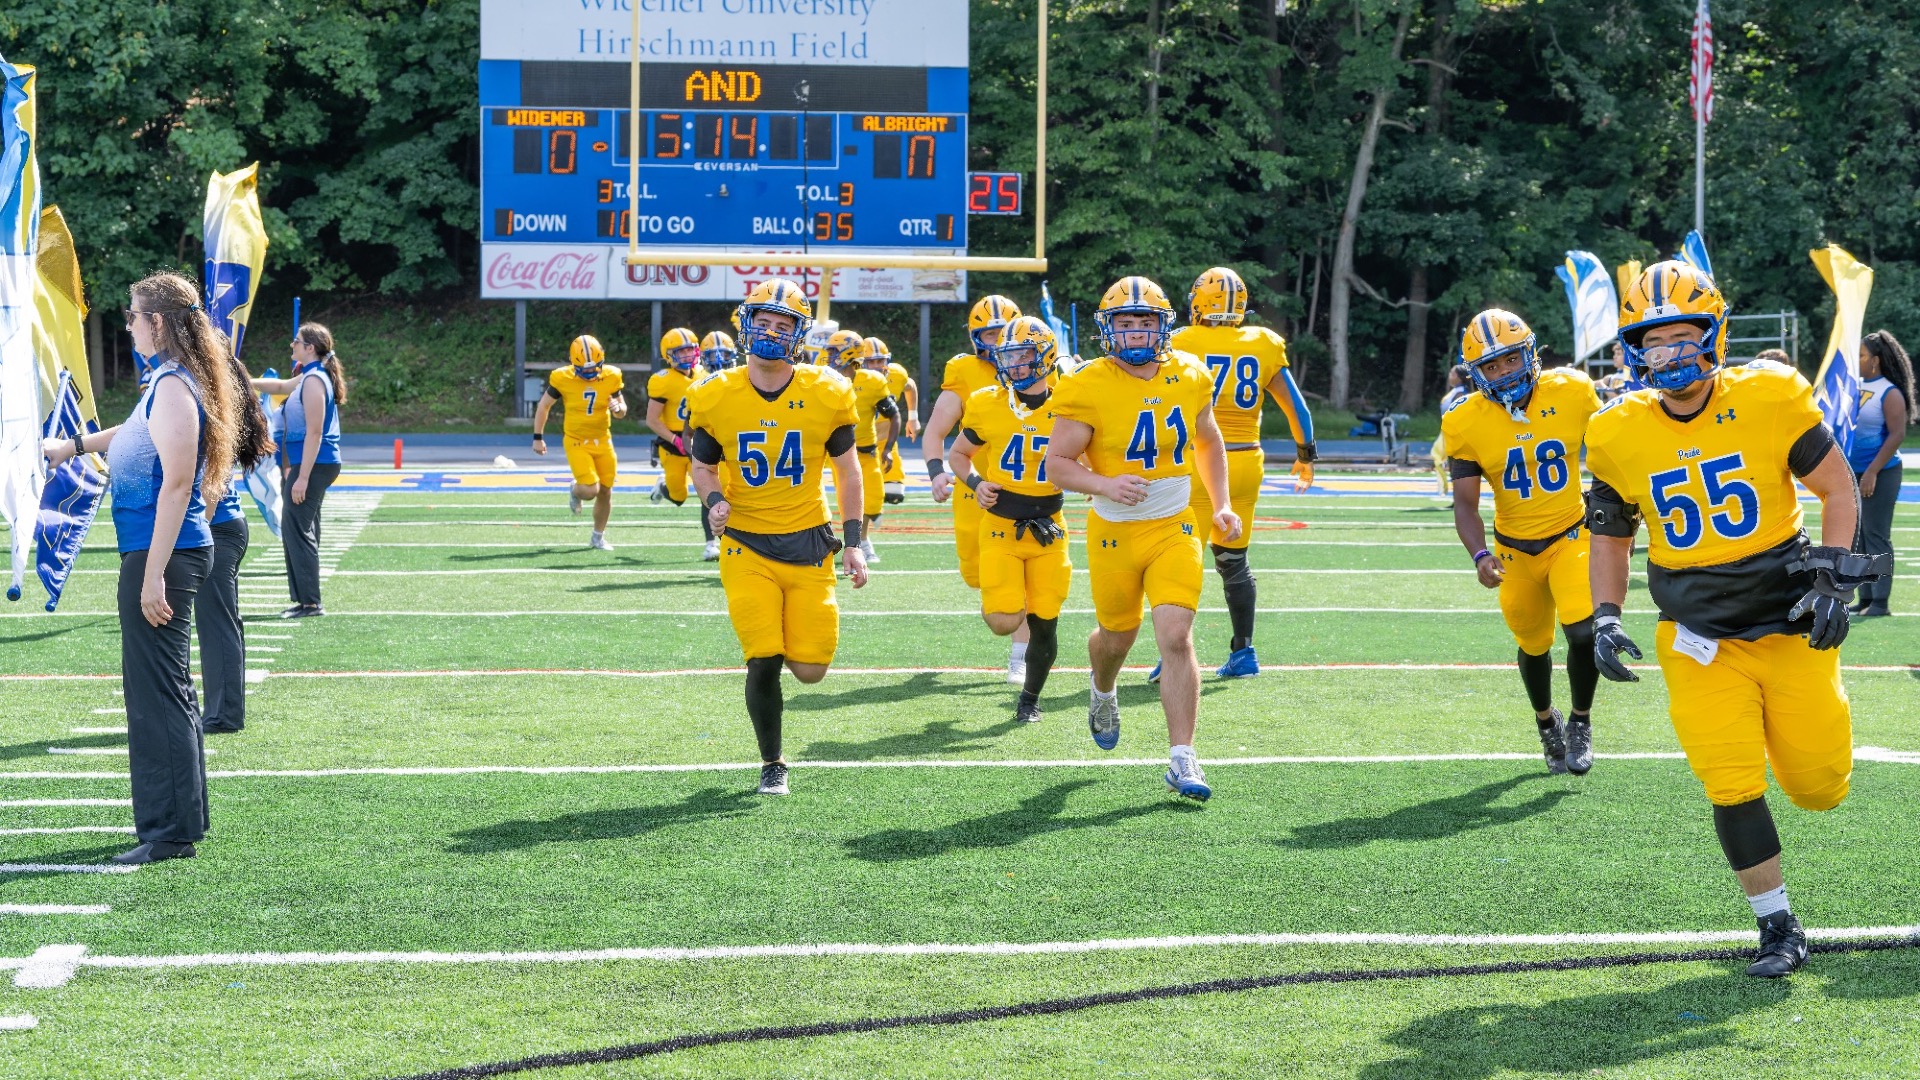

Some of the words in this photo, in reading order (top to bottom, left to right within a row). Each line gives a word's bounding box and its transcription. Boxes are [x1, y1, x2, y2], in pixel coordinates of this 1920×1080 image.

[578, 28, 776, 57] Hirschmann
[790, 31, 868, 58] Field
[685, 70, 761, 101] AND
[507, 110, 585, 127] WIDENER
[863, 116, 948, 132] ALBRIGHT
[551, 130, 577, 173] 0
[704, 162, 759, 171] EVERSAN
[600, 179, 613, 203] 3
[796, 185, 838, 201] TO.L.
[840, 183, 854, 206] 3
[969, 176, 1018, 210] 25
[514, 214, 567, 232] DOWN
[638, 215, 663, 233] TO
[667, 215, 695, 234] GO
[753, 217, 790, 234] BALL
[792, 217, 814, 234] ON
[815, 212, 853, 240] 35
[900, 219, 936, 236] QTR.
[487, 252, 599, 290] Coca-Cola
[622, 257, 711, 286] UNO
[1205, 353, 1260, 410] 78
[583, 391, 597, 415] 7
[1125, 405, 1188, 470] 41
[737, 430, 805, 487] 54
[999, 432, 1050, 484] 47
[1677, 446, 1701, 460] Pride
[1502, 439, 1569, 500] 48
[1648, 451, 1760, 550] 55
